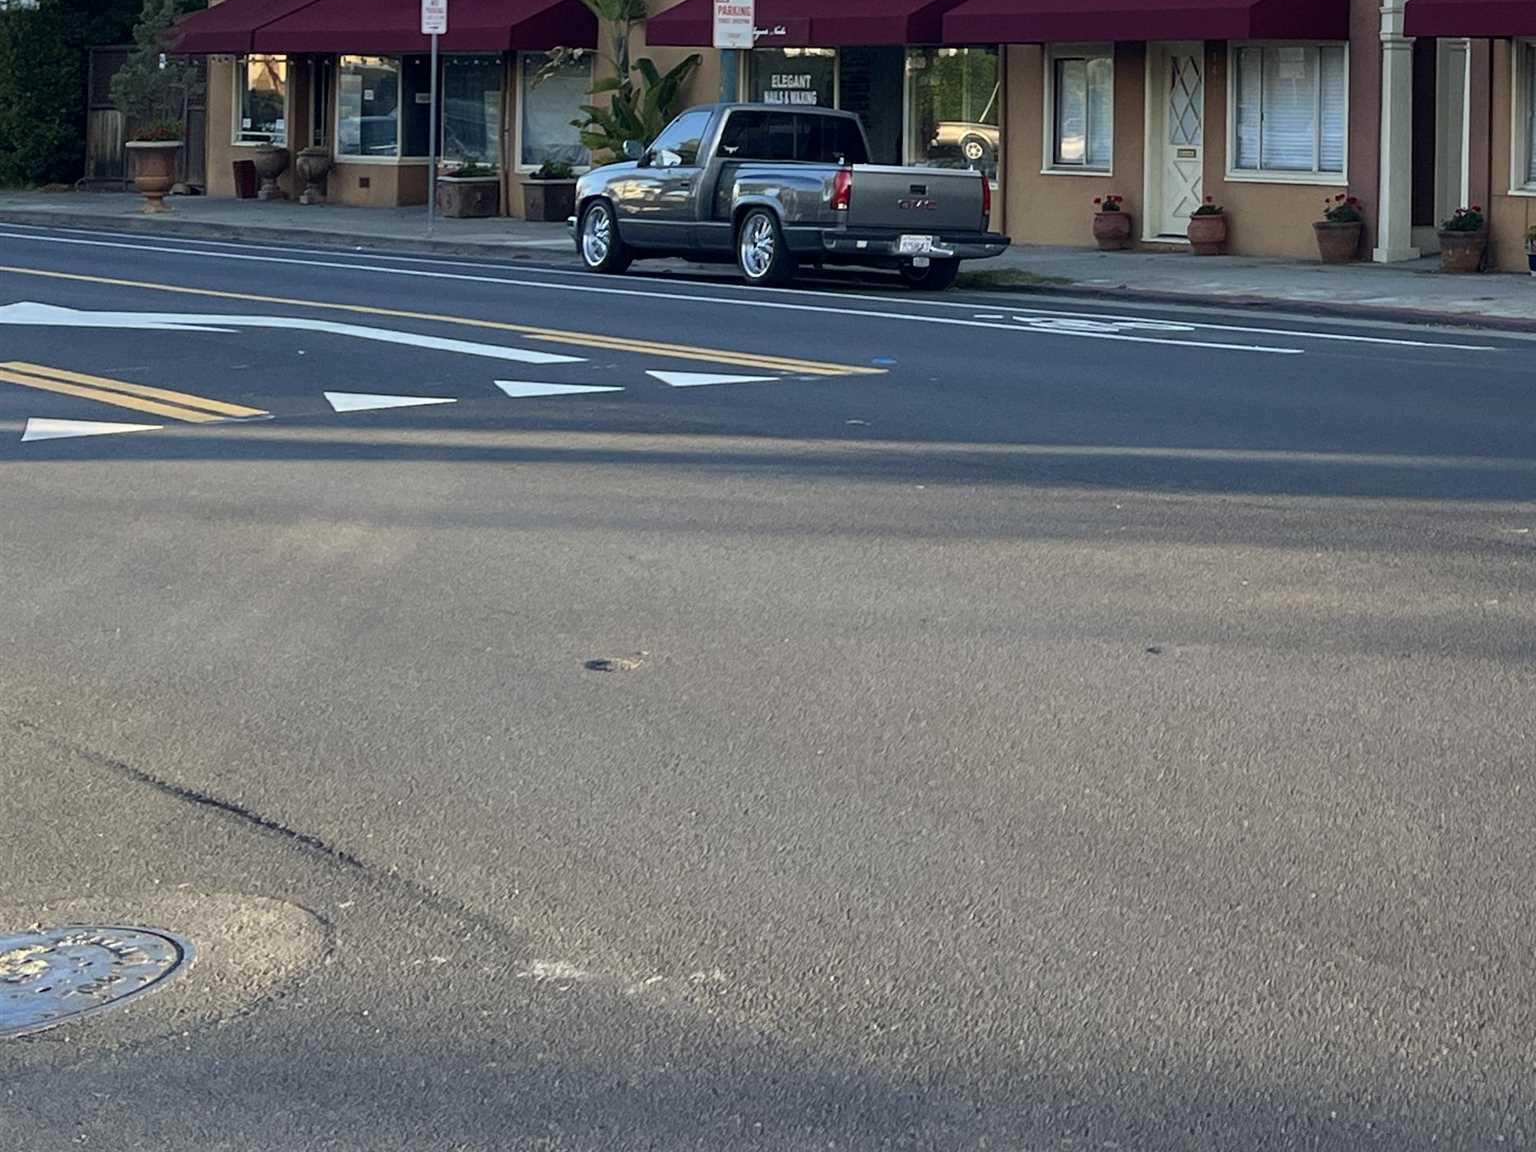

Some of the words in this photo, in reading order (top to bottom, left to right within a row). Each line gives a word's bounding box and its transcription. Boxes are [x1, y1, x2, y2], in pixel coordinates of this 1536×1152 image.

[718, 5, 752, 17] PARKING
[771, 75, 812, 88] ELEGANT
[763, 91, 783, 105] NAILS
[790, 91, 817, 105] WAXING
